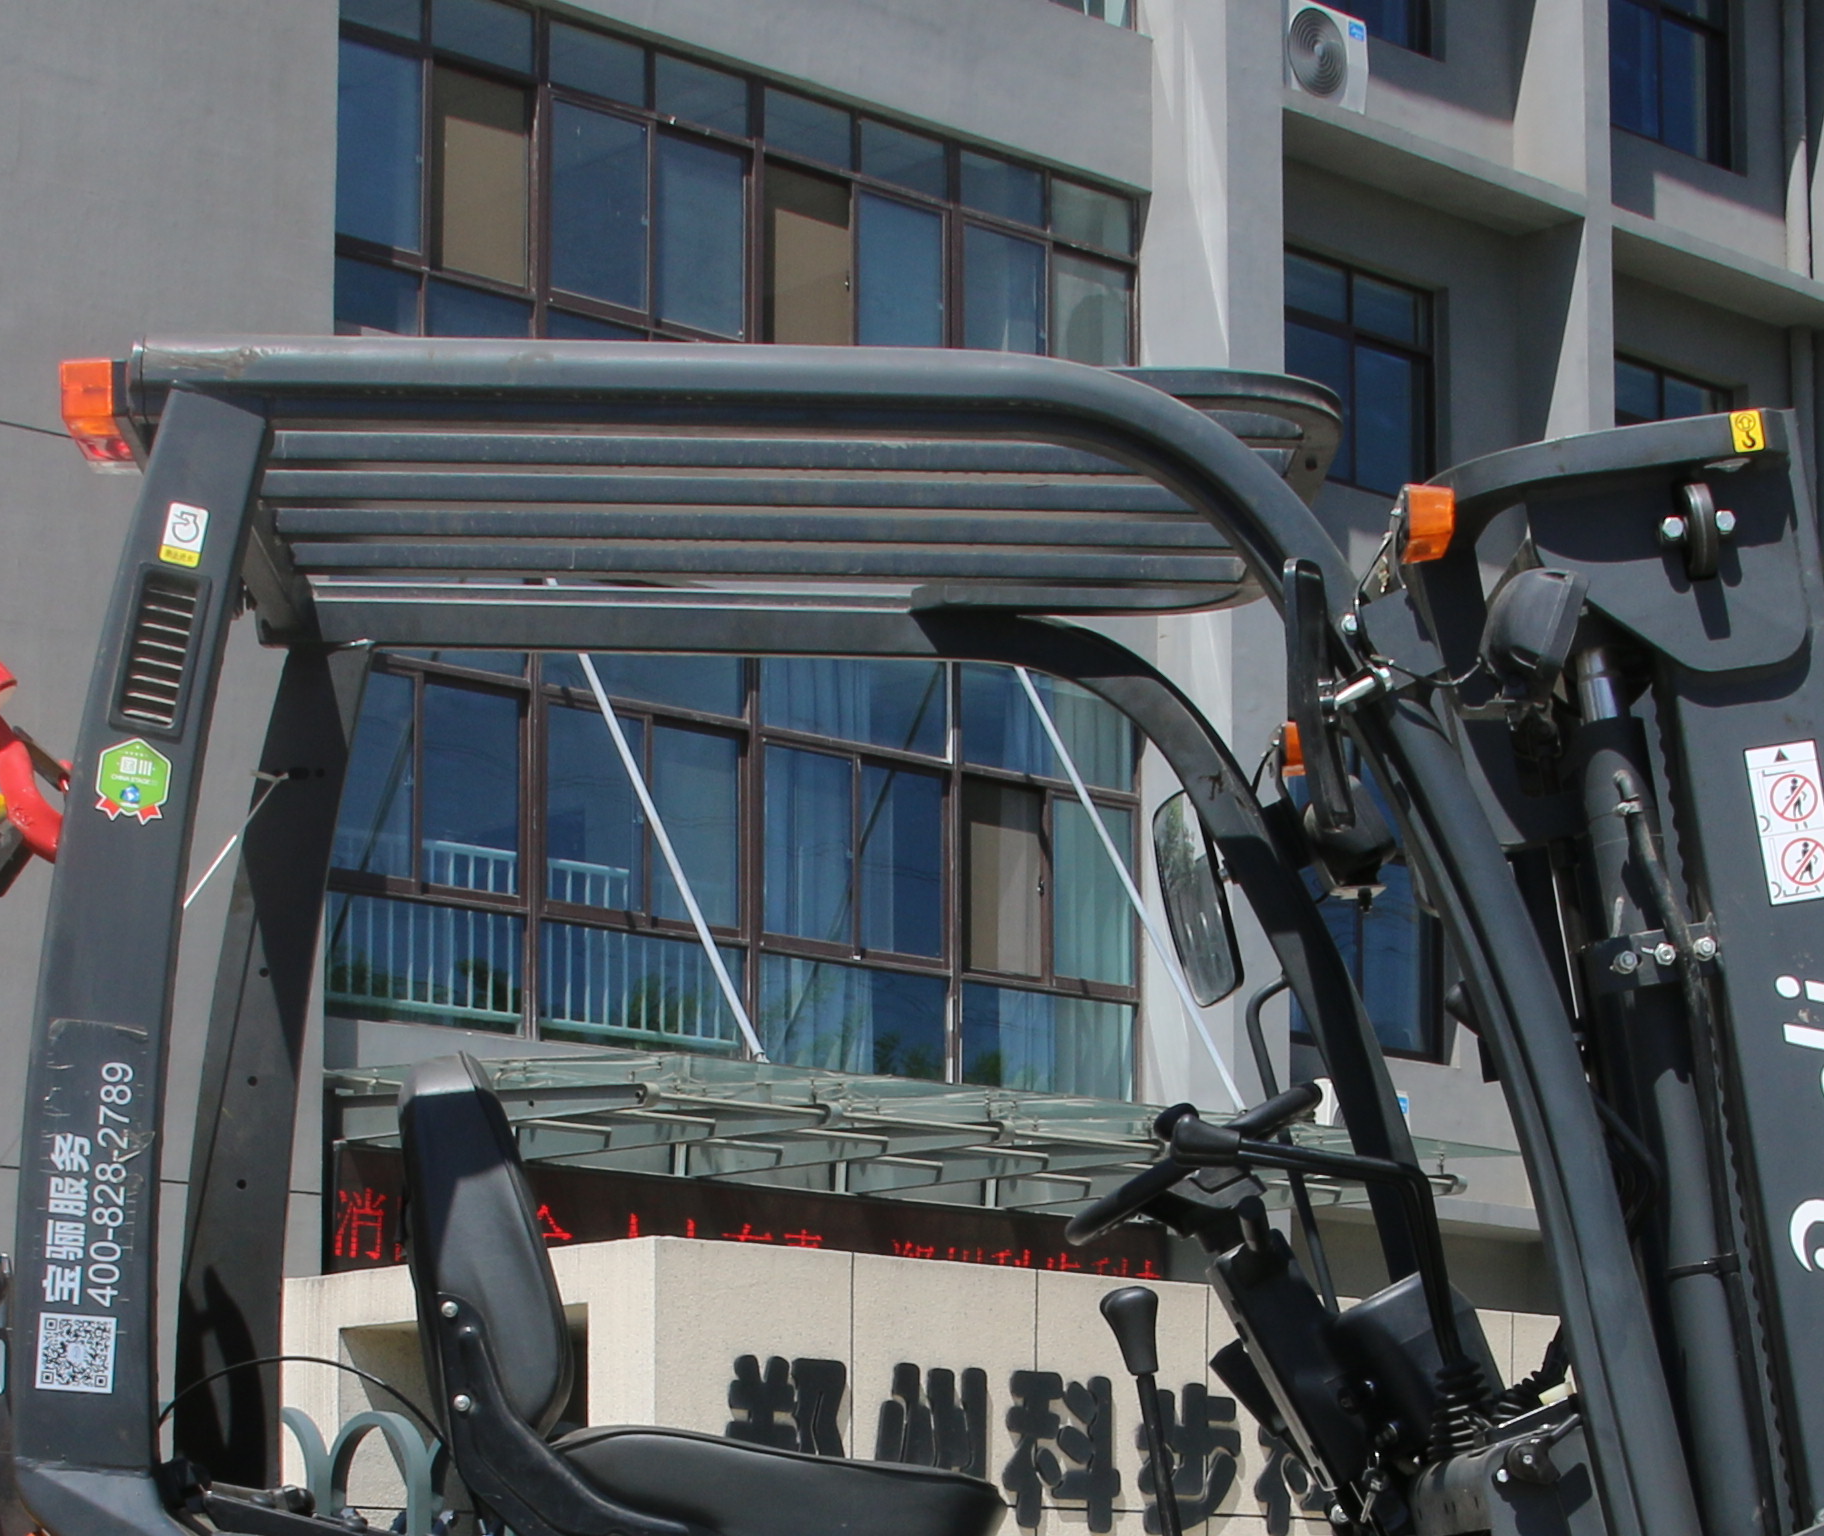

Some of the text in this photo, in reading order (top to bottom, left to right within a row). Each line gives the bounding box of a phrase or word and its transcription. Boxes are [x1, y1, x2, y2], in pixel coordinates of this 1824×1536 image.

[42, 1132, 90, 1306] 宝骊服务
[86, 1061, 134, 1309] 400-828-2789
